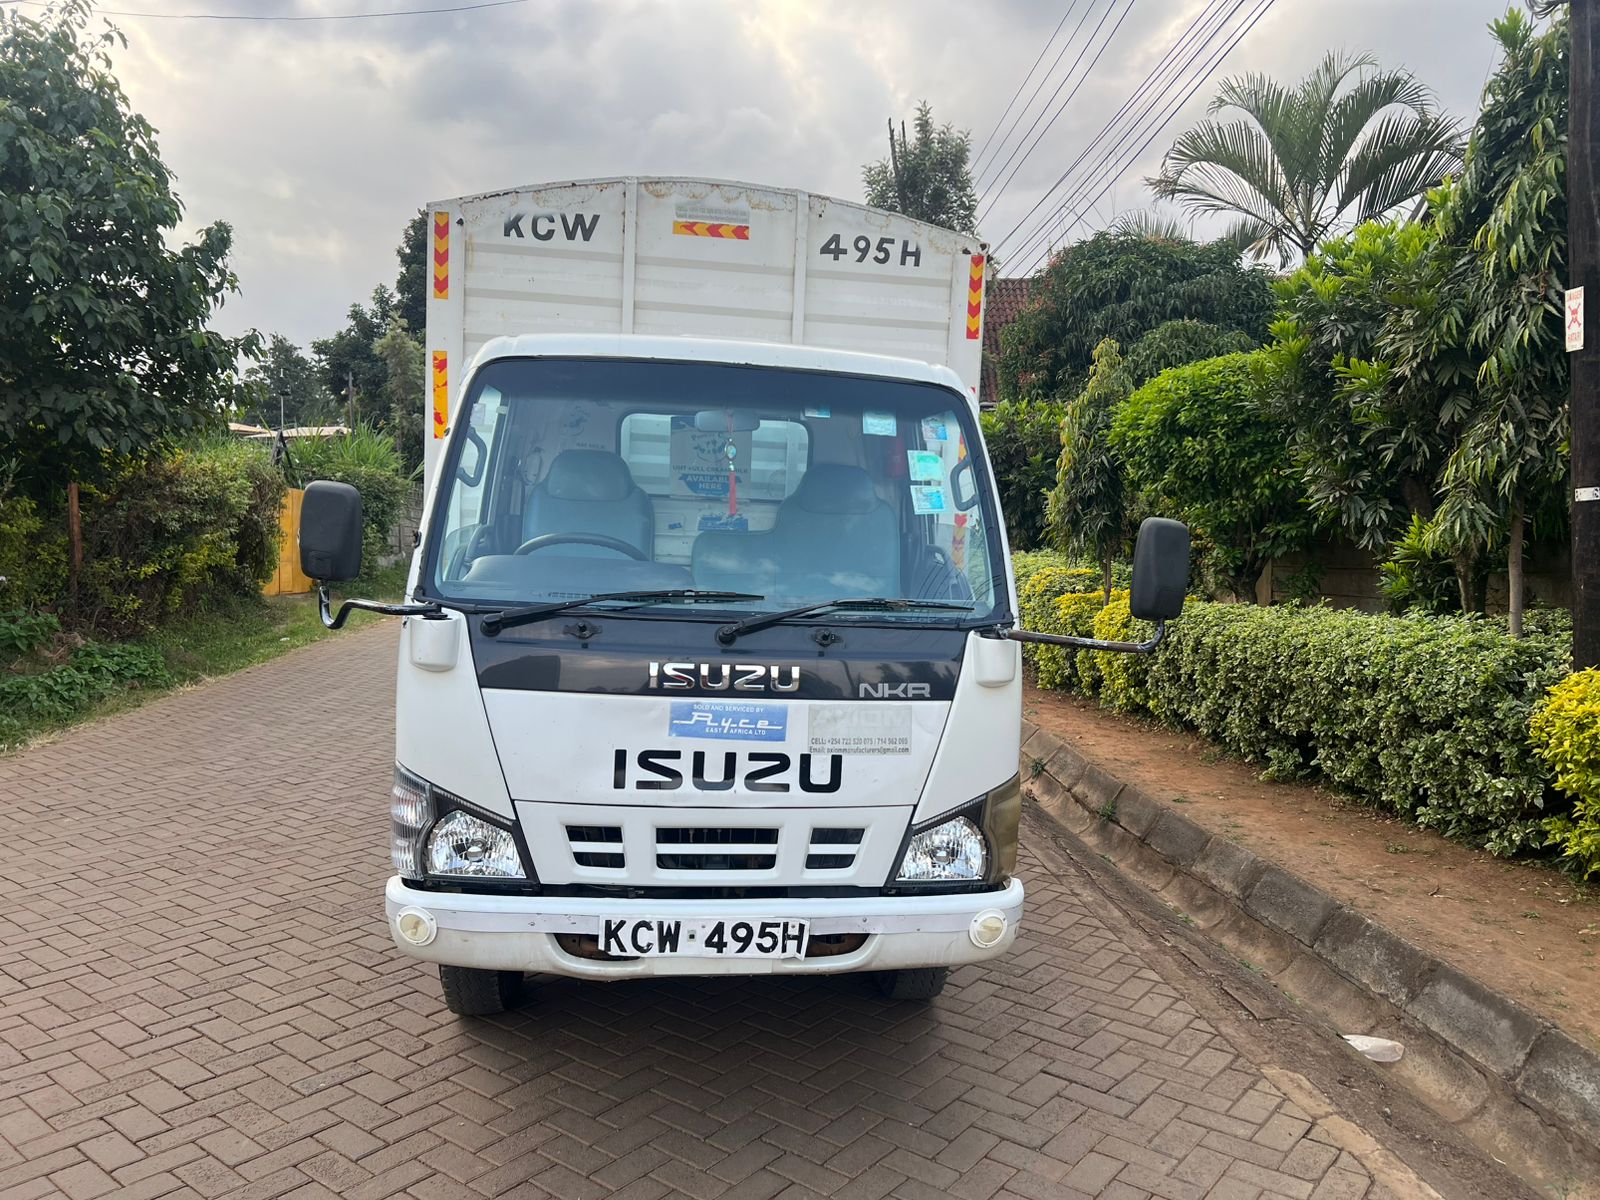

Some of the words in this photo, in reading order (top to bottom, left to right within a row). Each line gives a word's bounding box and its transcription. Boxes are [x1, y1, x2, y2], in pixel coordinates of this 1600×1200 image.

[503, 213, 601, 241] KCW
[819, 233, 922, 267] 495H
[649, 661, 800, 692] ISUZU
[859, 683, 931, 698] NKR
[613, 749, 843, 793] ISUZU
[604, 919, 682, 954] KCW
[704, 920, 806, 955] 495H
